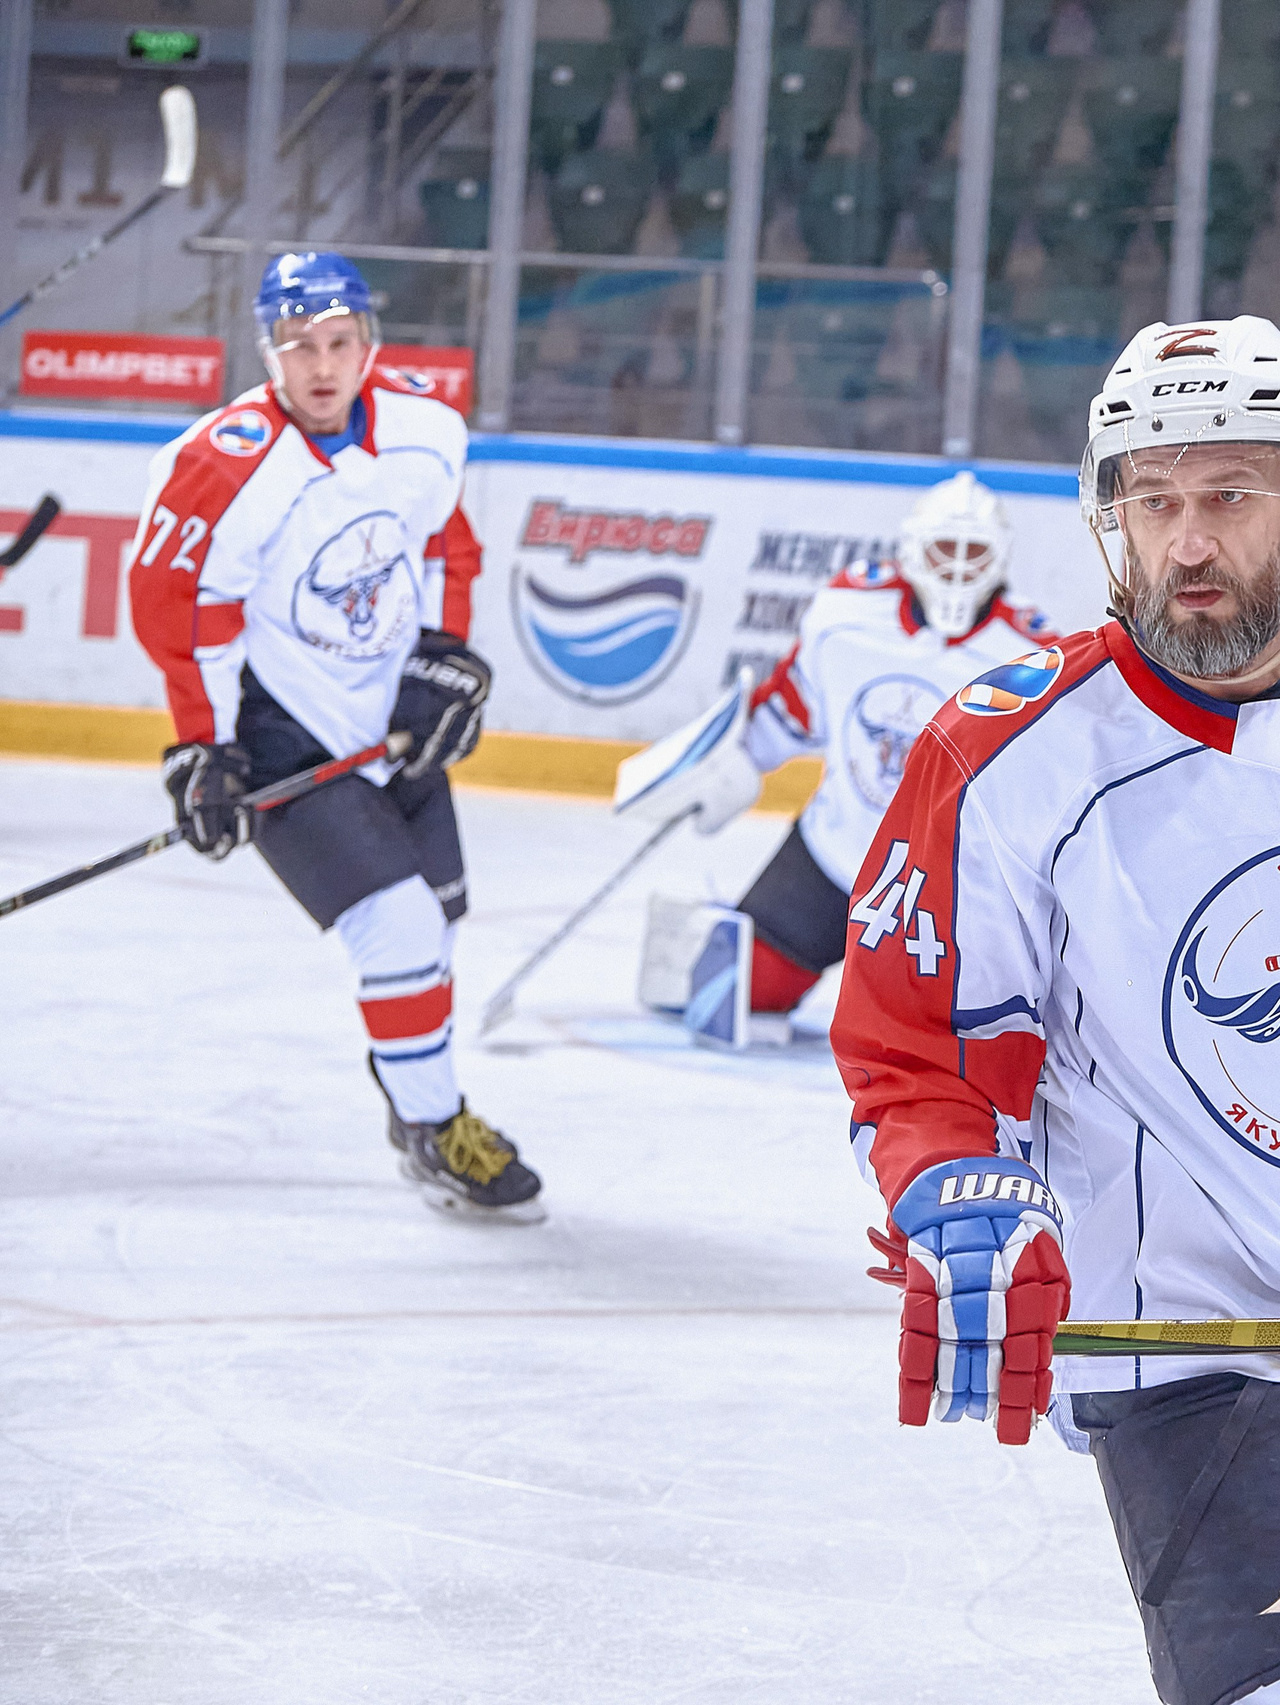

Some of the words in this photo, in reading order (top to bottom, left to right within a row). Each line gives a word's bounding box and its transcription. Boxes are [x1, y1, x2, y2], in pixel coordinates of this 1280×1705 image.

[26, 348, 220, 387] OLIMPBET
[1152, 380, 1229, 397] CCM
[140, 505, 207, 573] 72
[403, 657, 479, 695] AUER
[850, 838, 947, 977] 44
